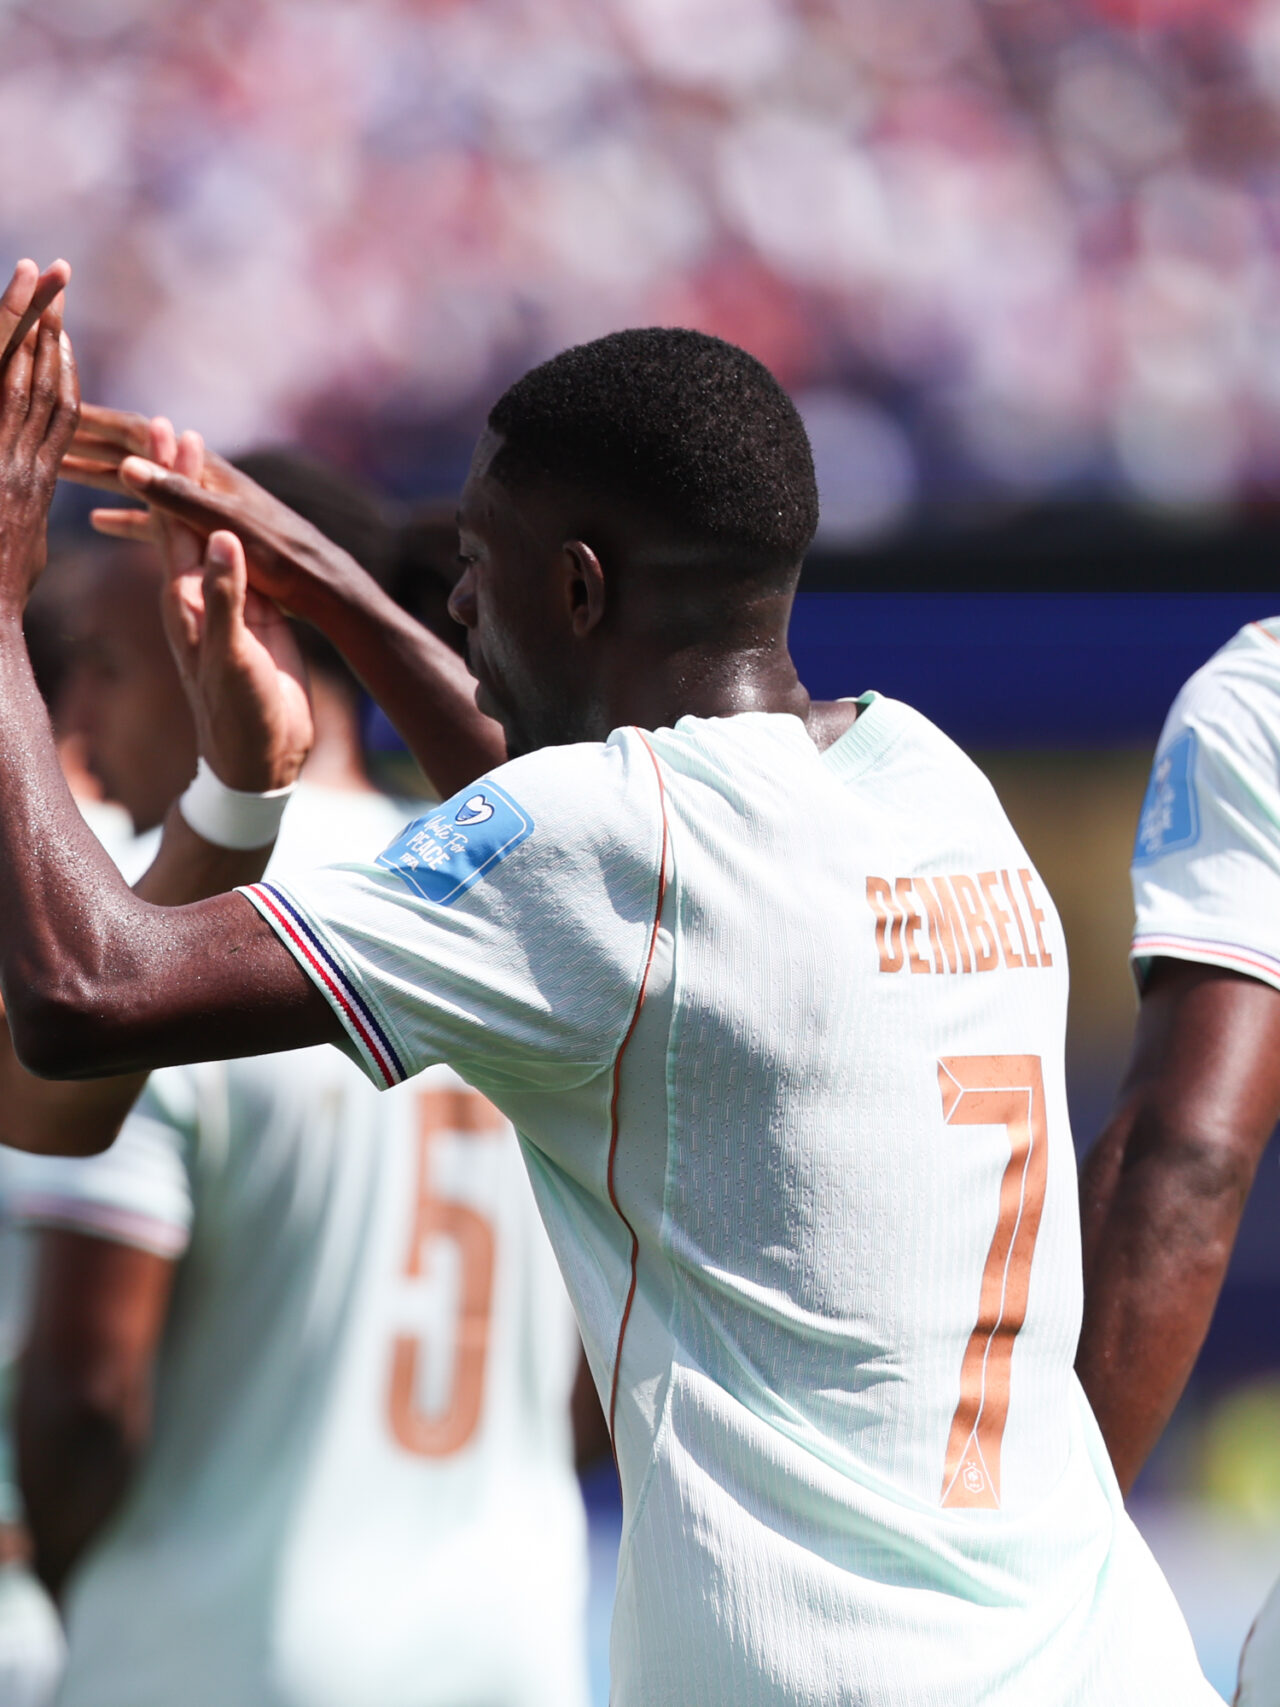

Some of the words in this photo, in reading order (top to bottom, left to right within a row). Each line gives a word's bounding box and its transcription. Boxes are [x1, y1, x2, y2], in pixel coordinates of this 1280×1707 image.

[400, 853, 419, 871] FIFA
[406, 830, 451, 871] PEACE
[443, 833, 468, 853] For
[865, 868, 1053, 974] DEMBELE
[386, 1089, 504, 1458] 5
[937, 1054, 1049, 1510] 7
